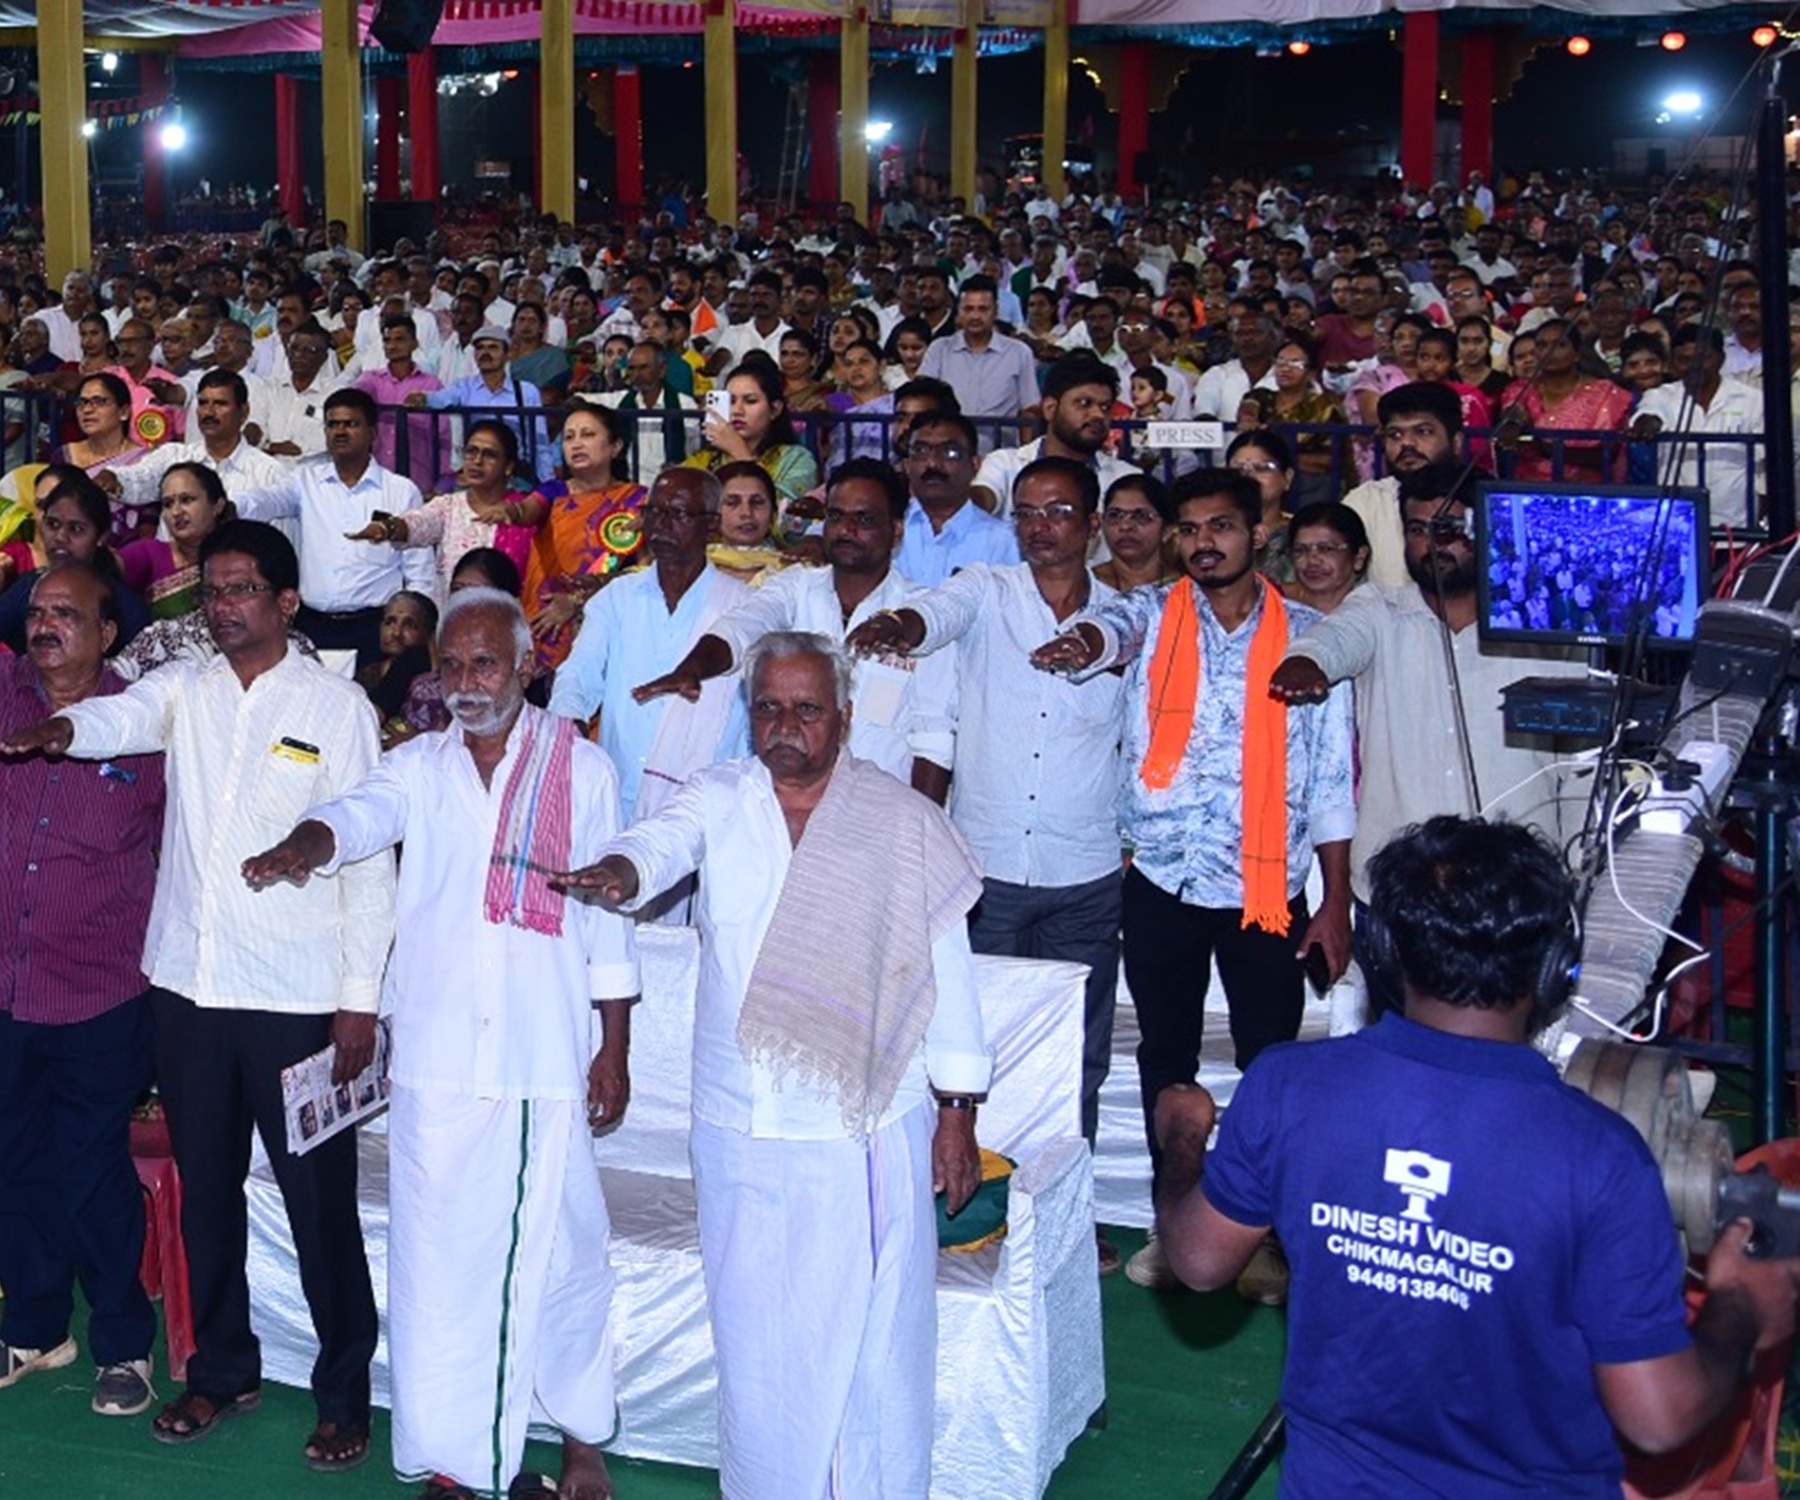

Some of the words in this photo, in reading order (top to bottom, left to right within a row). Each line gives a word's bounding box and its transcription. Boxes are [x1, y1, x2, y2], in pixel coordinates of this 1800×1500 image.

[1156, 428, 1215, 443] PRESS
[1312, 1203, 1419, 1247] DINESH
[1427, 1226, 1514, 1270] VIDEO
[1328, 1235, 1493, 1293] CHIKMAGALUR
